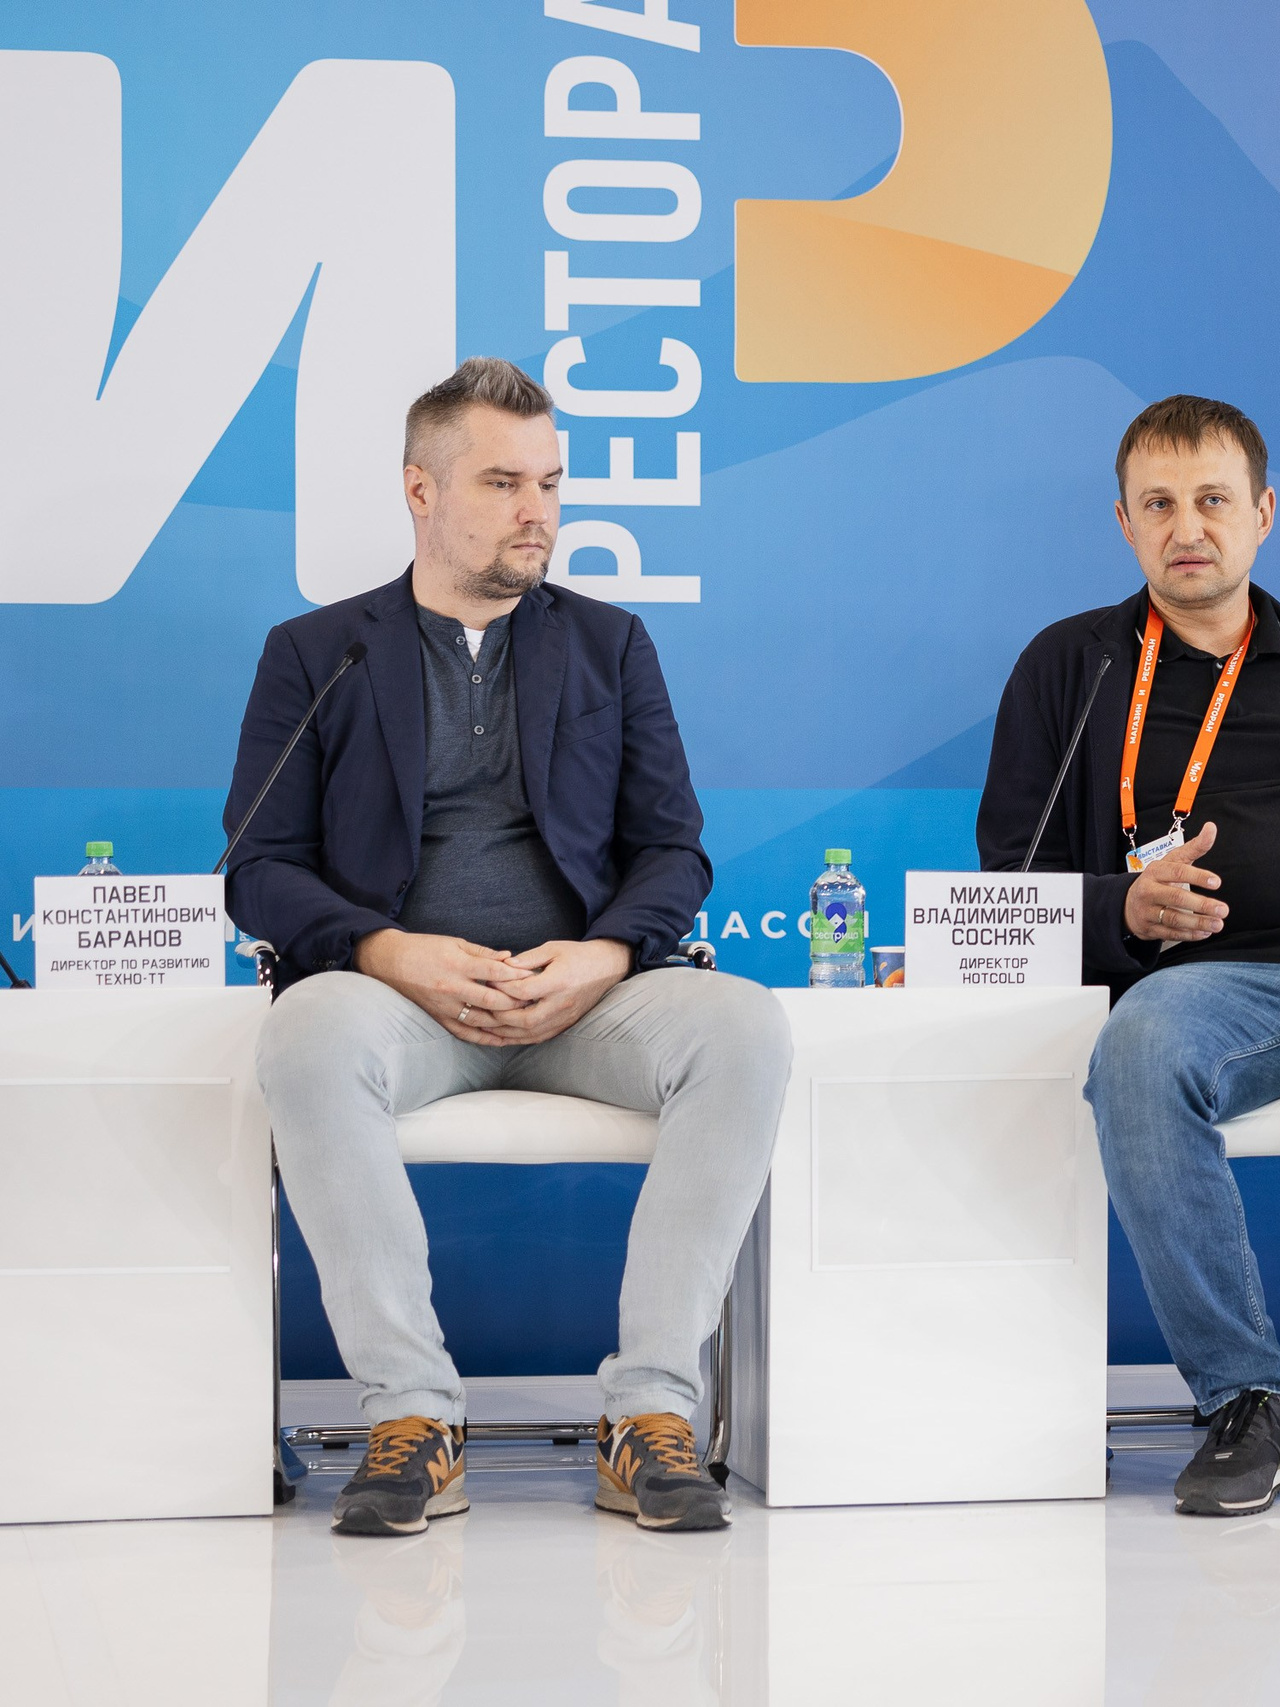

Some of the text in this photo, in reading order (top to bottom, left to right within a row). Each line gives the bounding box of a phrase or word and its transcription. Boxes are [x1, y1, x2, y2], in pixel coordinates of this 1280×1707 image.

[1129, 703, 1143, 745] МАГАЗИН
[1141, 638, 1156, 682] РЕСТОРАН
[1205, 693, 1225, 733] РЕСТОРАН
[93, 885, 166, 904] ПАВЕЛ
[950, 887, 1038, 905] МИХАИЛ
[43, 906, 217, 925] КОНСТАНТИНОВИЧ
[913, 908, 1075, 926] ВЛАДИМИРОВИЧ
[78, 929, 182, 949] БАРАНОВ
[951, 929, 1036, 946] СОСНЯК
[50, 957, 210, 972] ДИРЕКТОР ПО РАЗВИТИЮ
[959, 957, 1028, 971] ДИРЕКТОР
[95, 973, 165, 986] ТЕХНО-ТТ
[962, 972, 1025, 984] HOTCOLD
